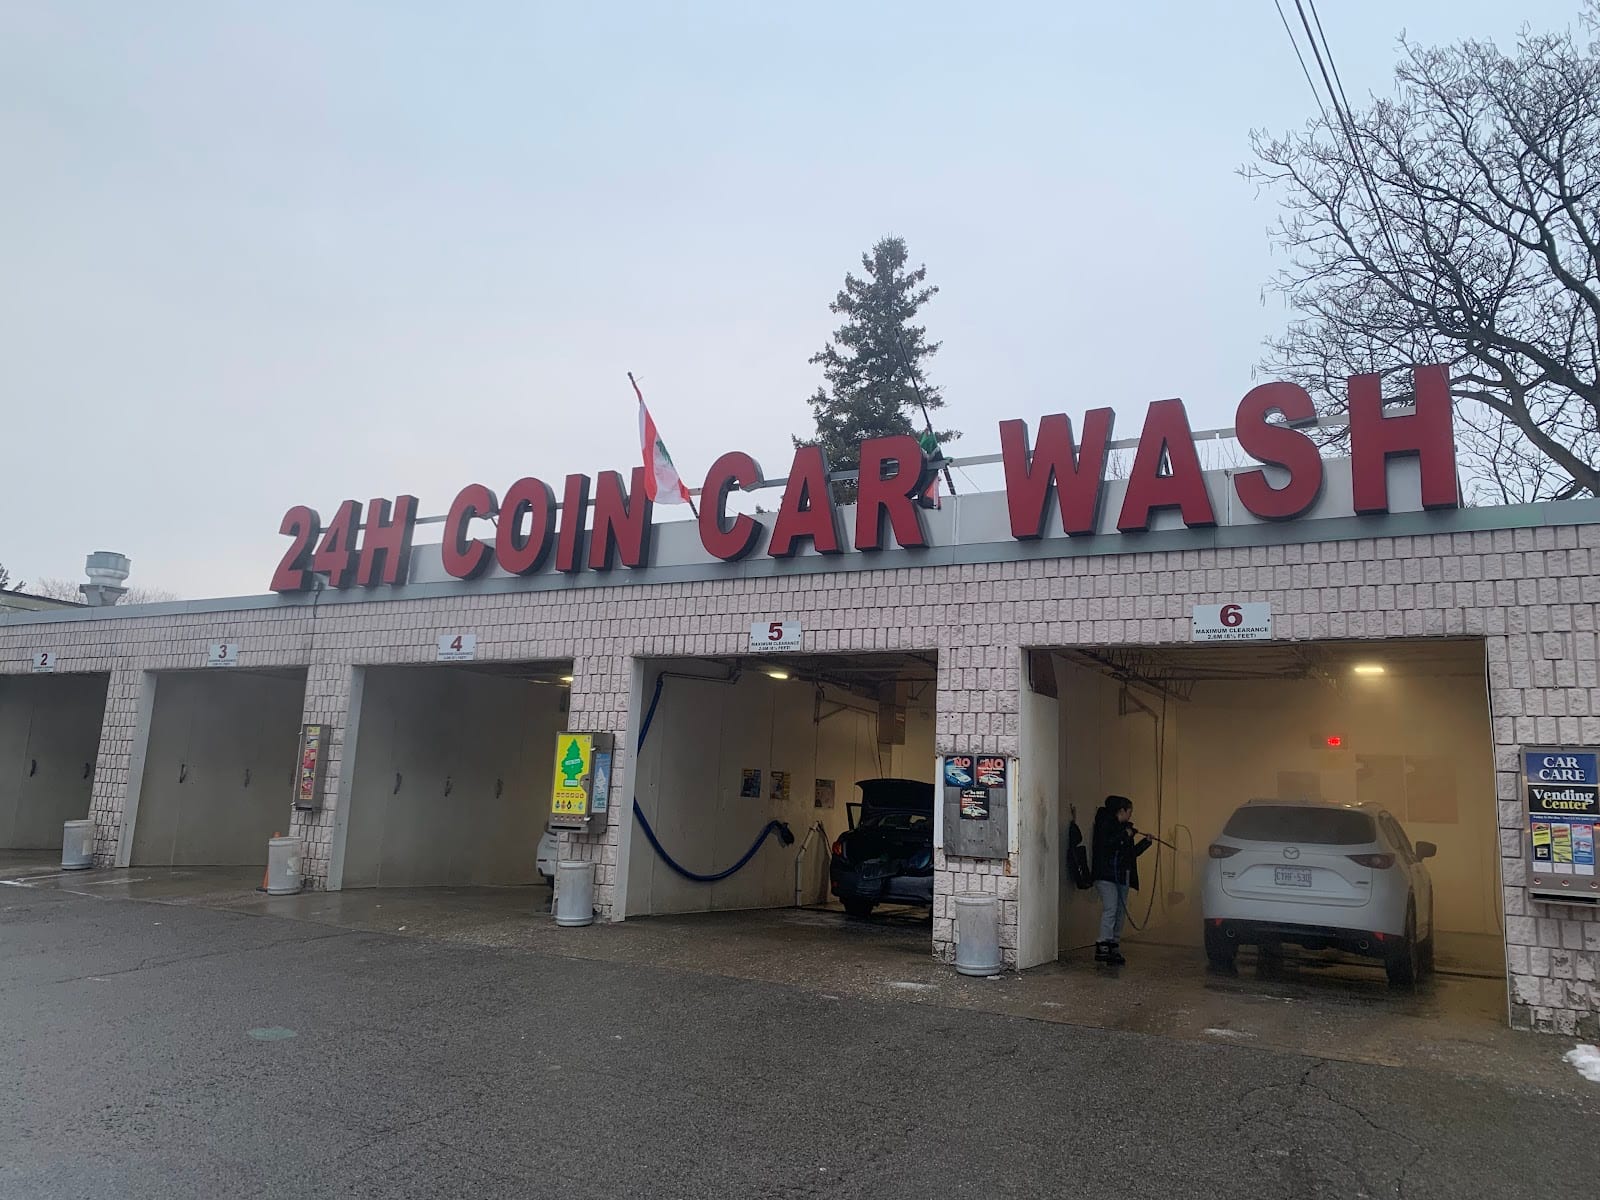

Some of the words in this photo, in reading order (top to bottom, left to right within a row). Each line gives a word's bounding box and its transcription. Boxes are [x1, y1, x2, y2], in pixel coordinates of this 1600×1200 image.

[270, 495, 419, 593] 24H
[441, 466, 653, 580] COIN
[700, 434, 930, 563] CAR
[999, 363, 1460, 541] WASH
[1220, 604, 1243, 627] 6
[768, 622, 783, 641] 5
[450, 635, 463, 651] 4
[218, 645, 228, 659] 3
[40, 653, 48, 666] 2
[954, 758, 970, 767] NO
[985, 759, 1004, 768] NO
[1543, 757, 1579, 768] CAR
[1539, 769, 1585, 780] CARE
[1532, 789, 1594, 804] Vending
[1542, 799, 1588, 809] Center
